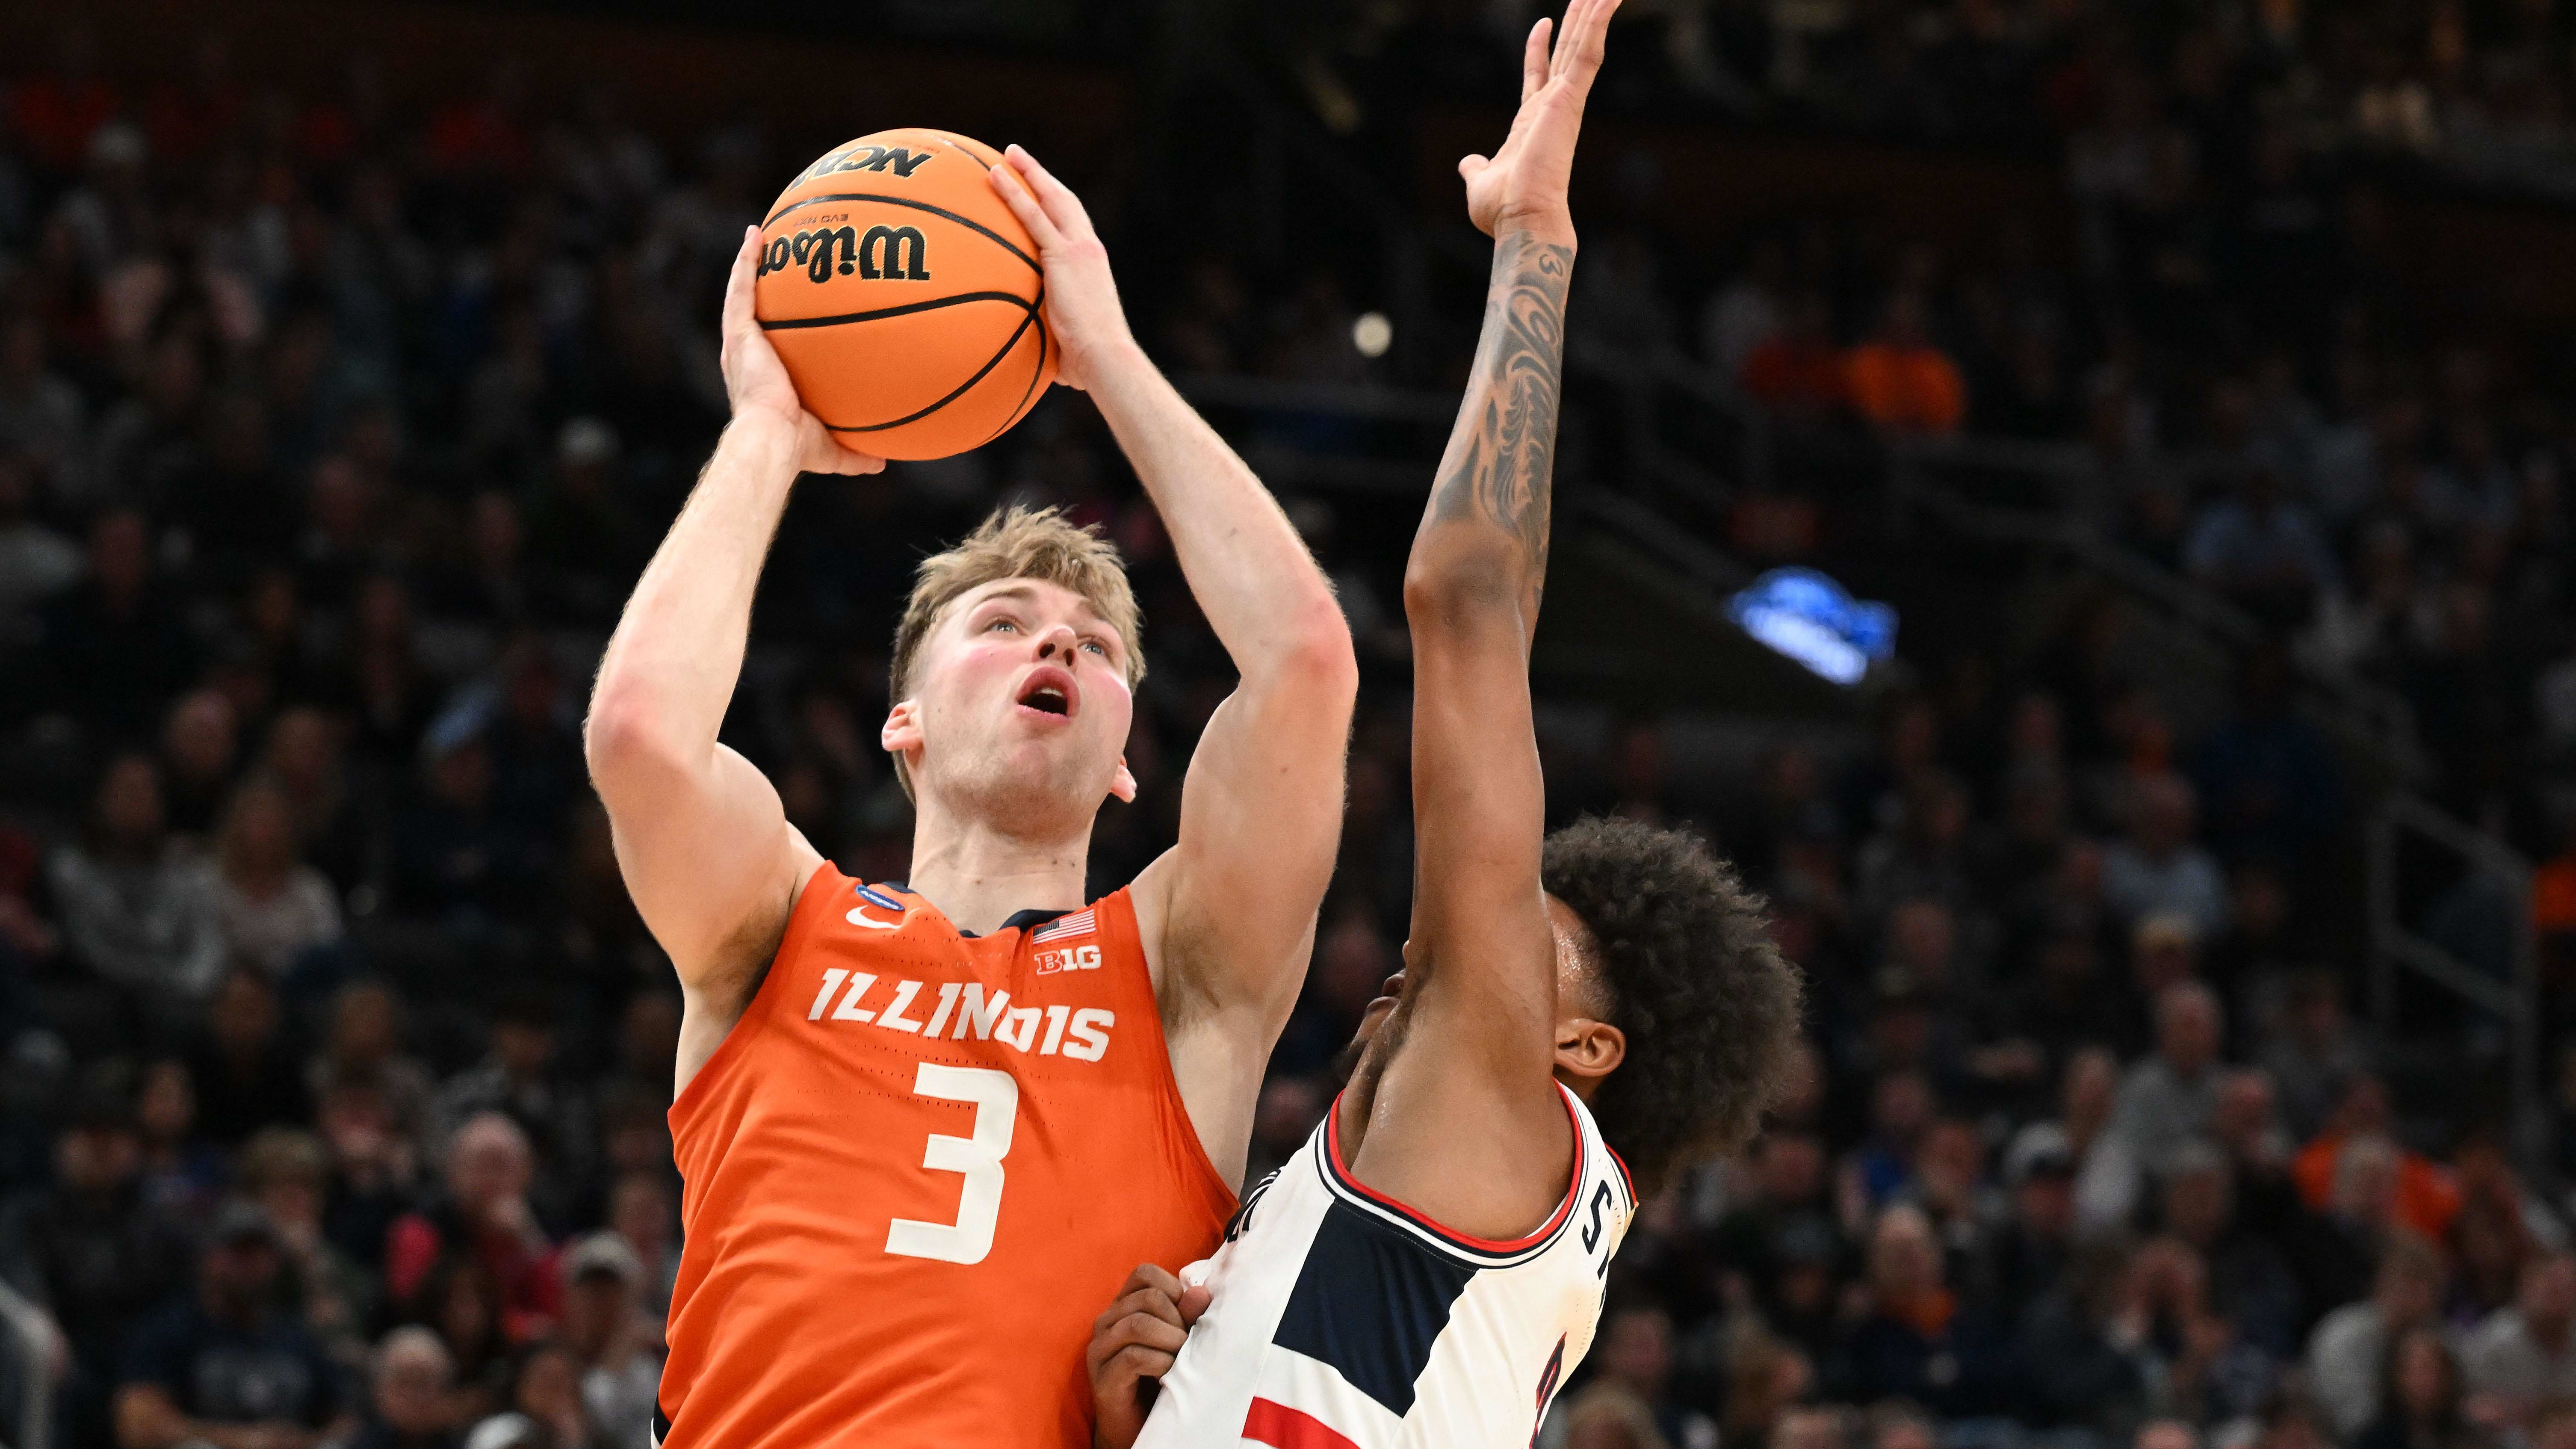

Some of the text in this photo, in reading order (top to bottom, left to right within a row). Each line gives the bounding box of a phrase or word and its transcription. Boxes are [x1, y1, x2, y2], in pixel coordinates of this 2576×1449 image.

[756, 225, 930, 284] Wilson
[808, 968, 1114, 1062] ILLINOIS
[884, 1062, 1019, 1265] 3
